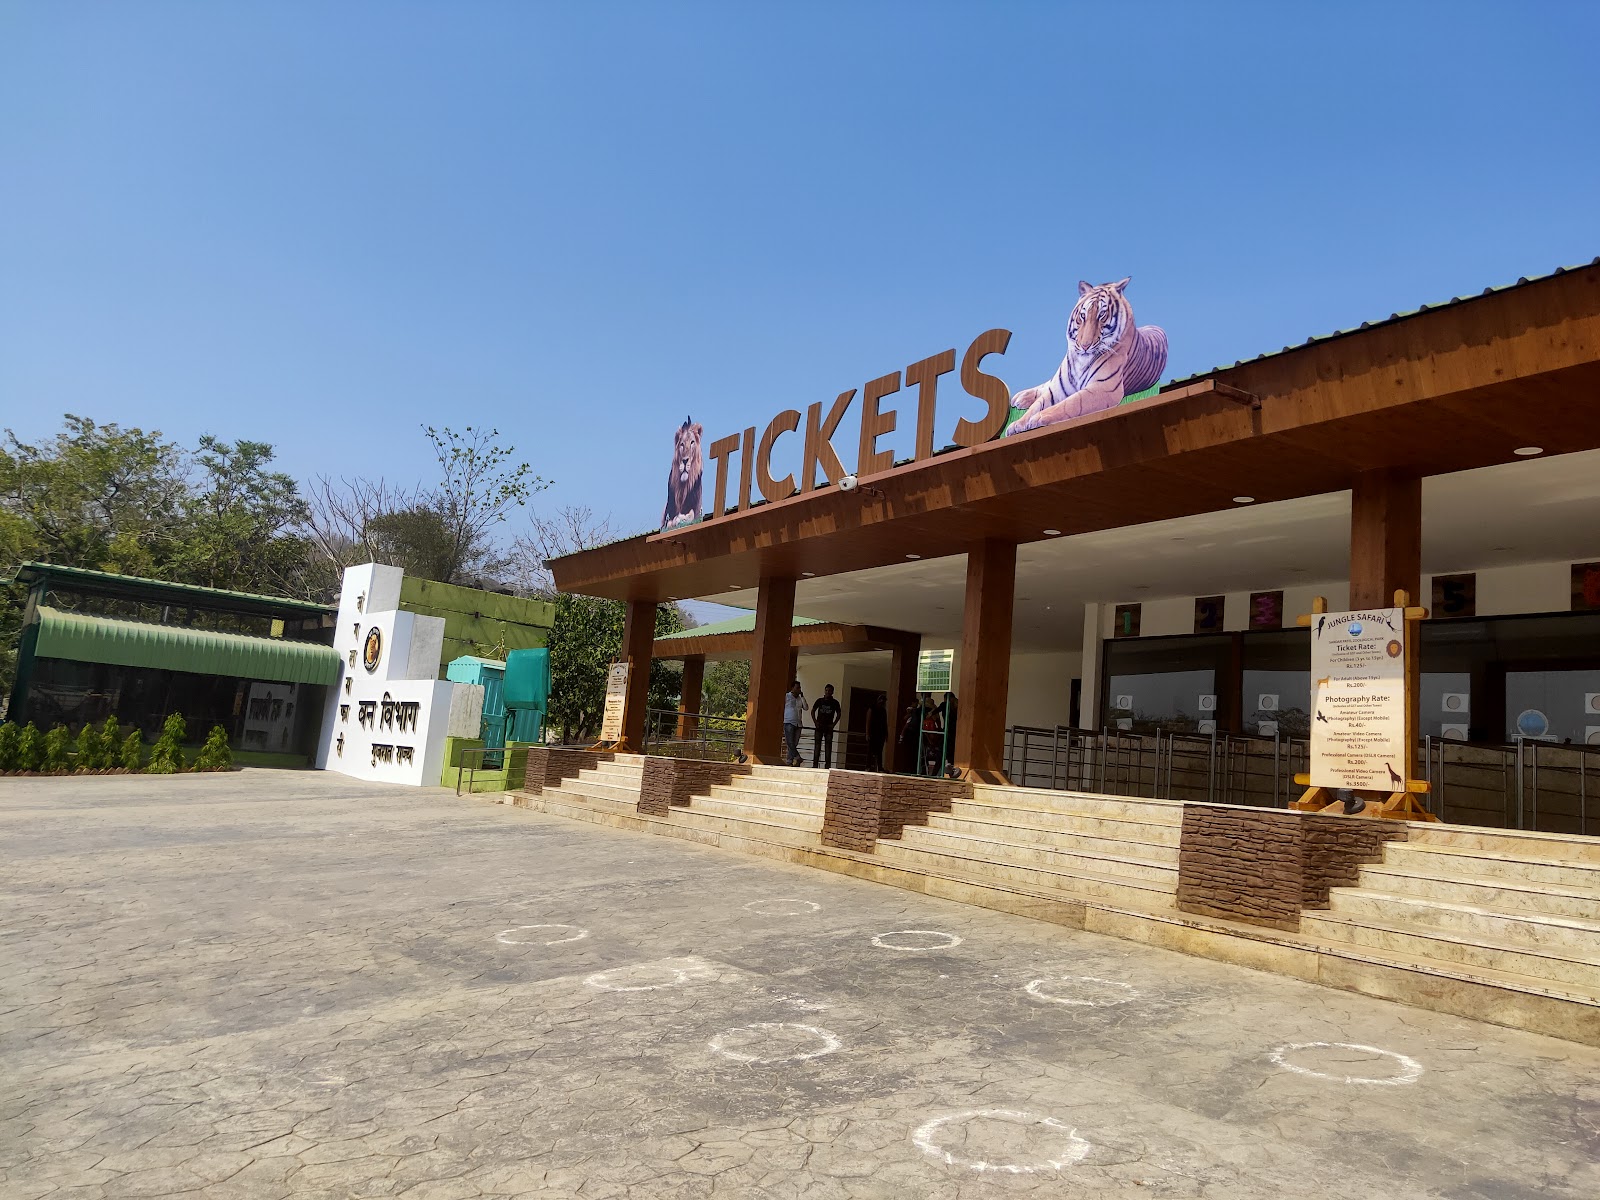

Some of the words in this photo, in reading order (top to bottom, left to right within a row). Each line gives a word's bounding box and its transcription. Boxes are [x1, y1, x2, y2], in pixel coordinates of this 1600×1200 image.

[709, 329, 1013, 519] TICKETS
[1443, 580, 1465, 612] 5
[1122, 609, 1132, 635] 1
[1200, 602, 1217, 627] 2
[1327, 614, 1355, 629] JUNGLE
[1357, 614, 1385, 625] SAFARI
[1325, 695, 1370, 703] Photography
[358, 700, 377, 730] वन
[380, 691, 420, 734] विभाग
[371, 743, 393, 768] गुजरात
[396, 744, 414, 768] राज्य
